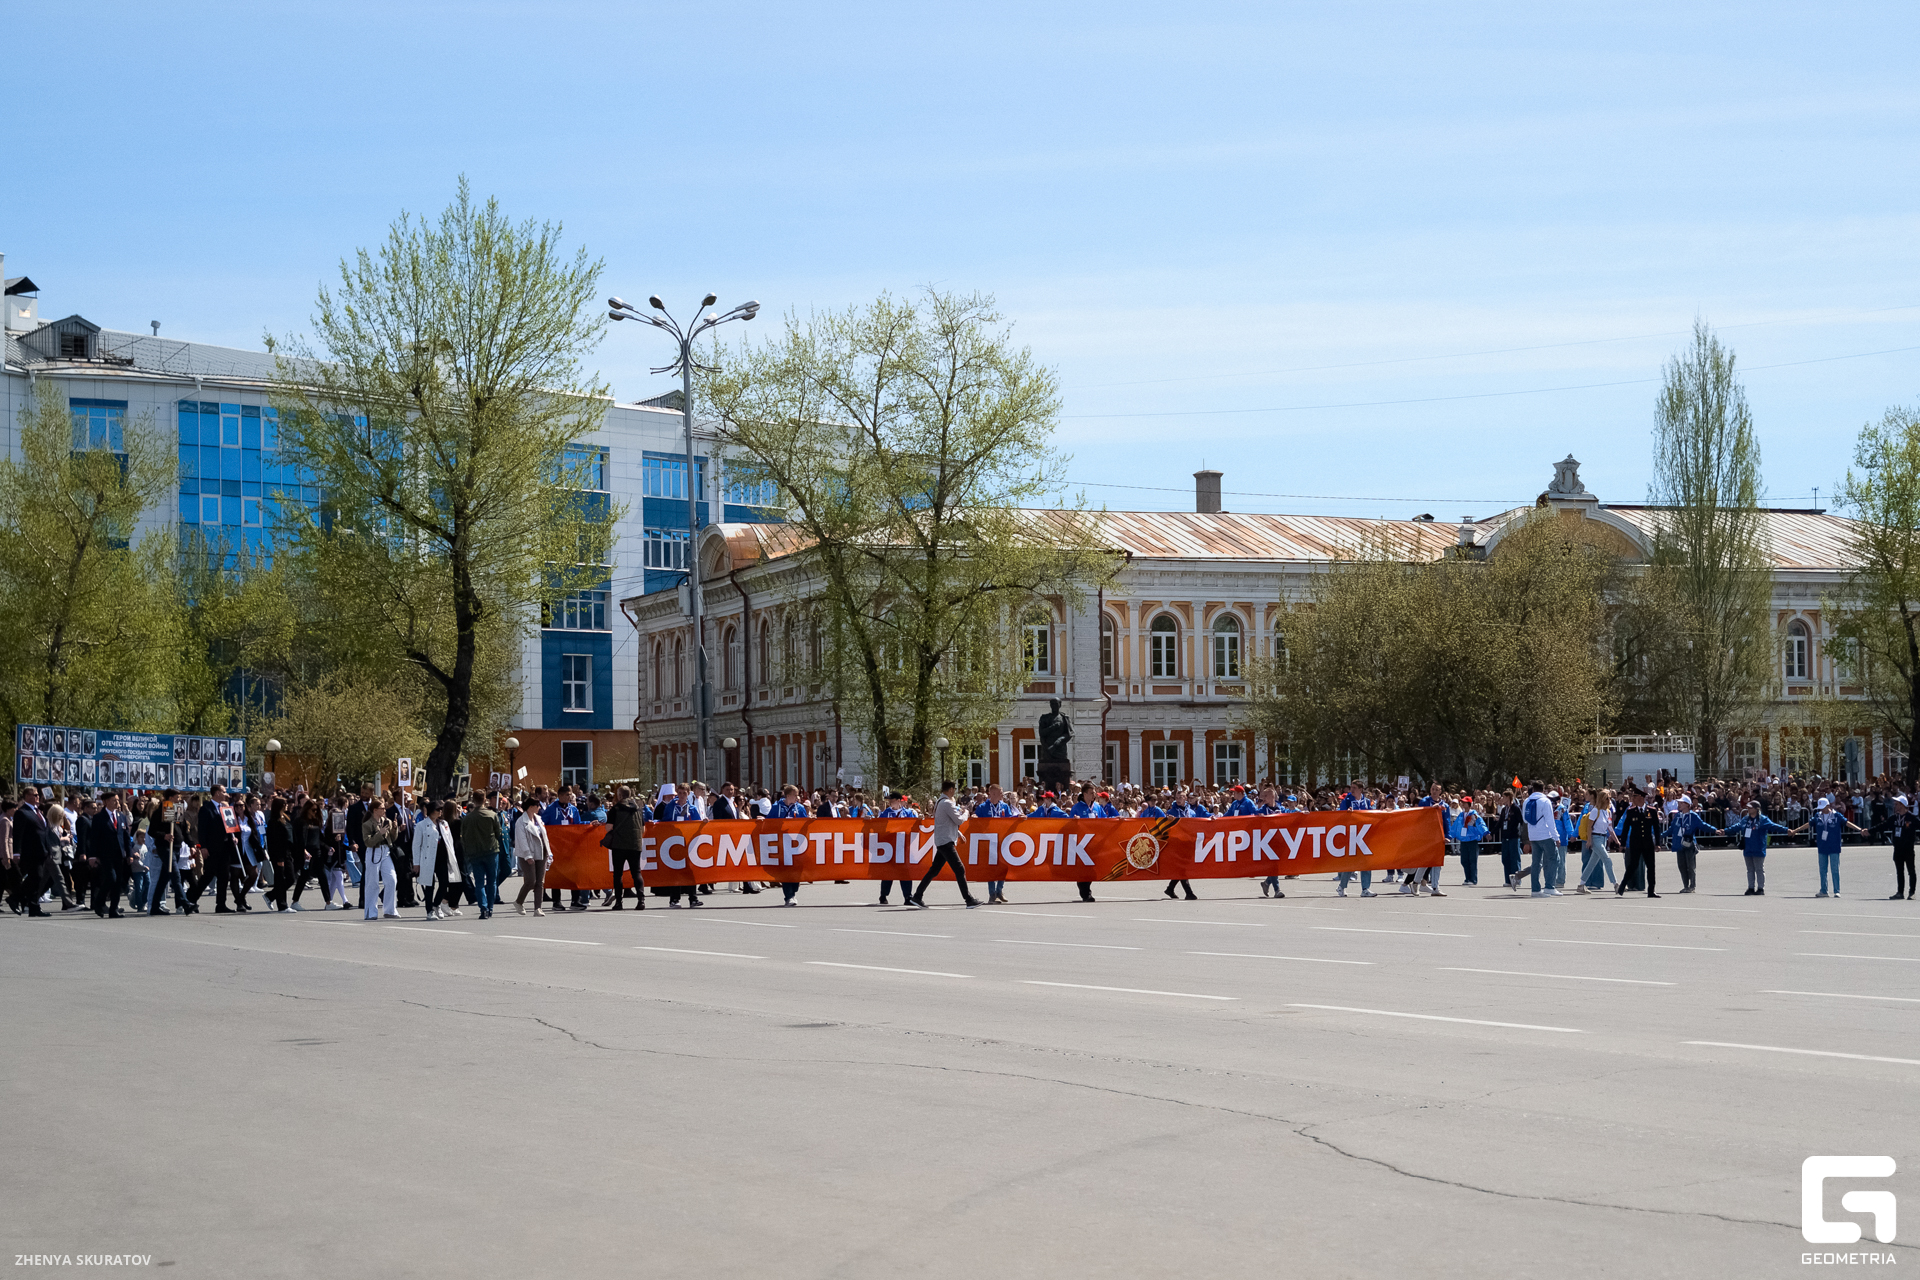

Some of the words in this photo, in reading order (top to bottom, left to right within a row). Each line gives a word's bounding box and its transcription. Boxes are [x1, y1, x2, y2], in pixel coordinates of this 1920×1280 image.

[609, 825, 937, 872] ЕССМЕРТНЫЙ
[968, 832, 1096, 867] ПОЛК
[1194, 823, 1374, 864] ИРКУТСК
